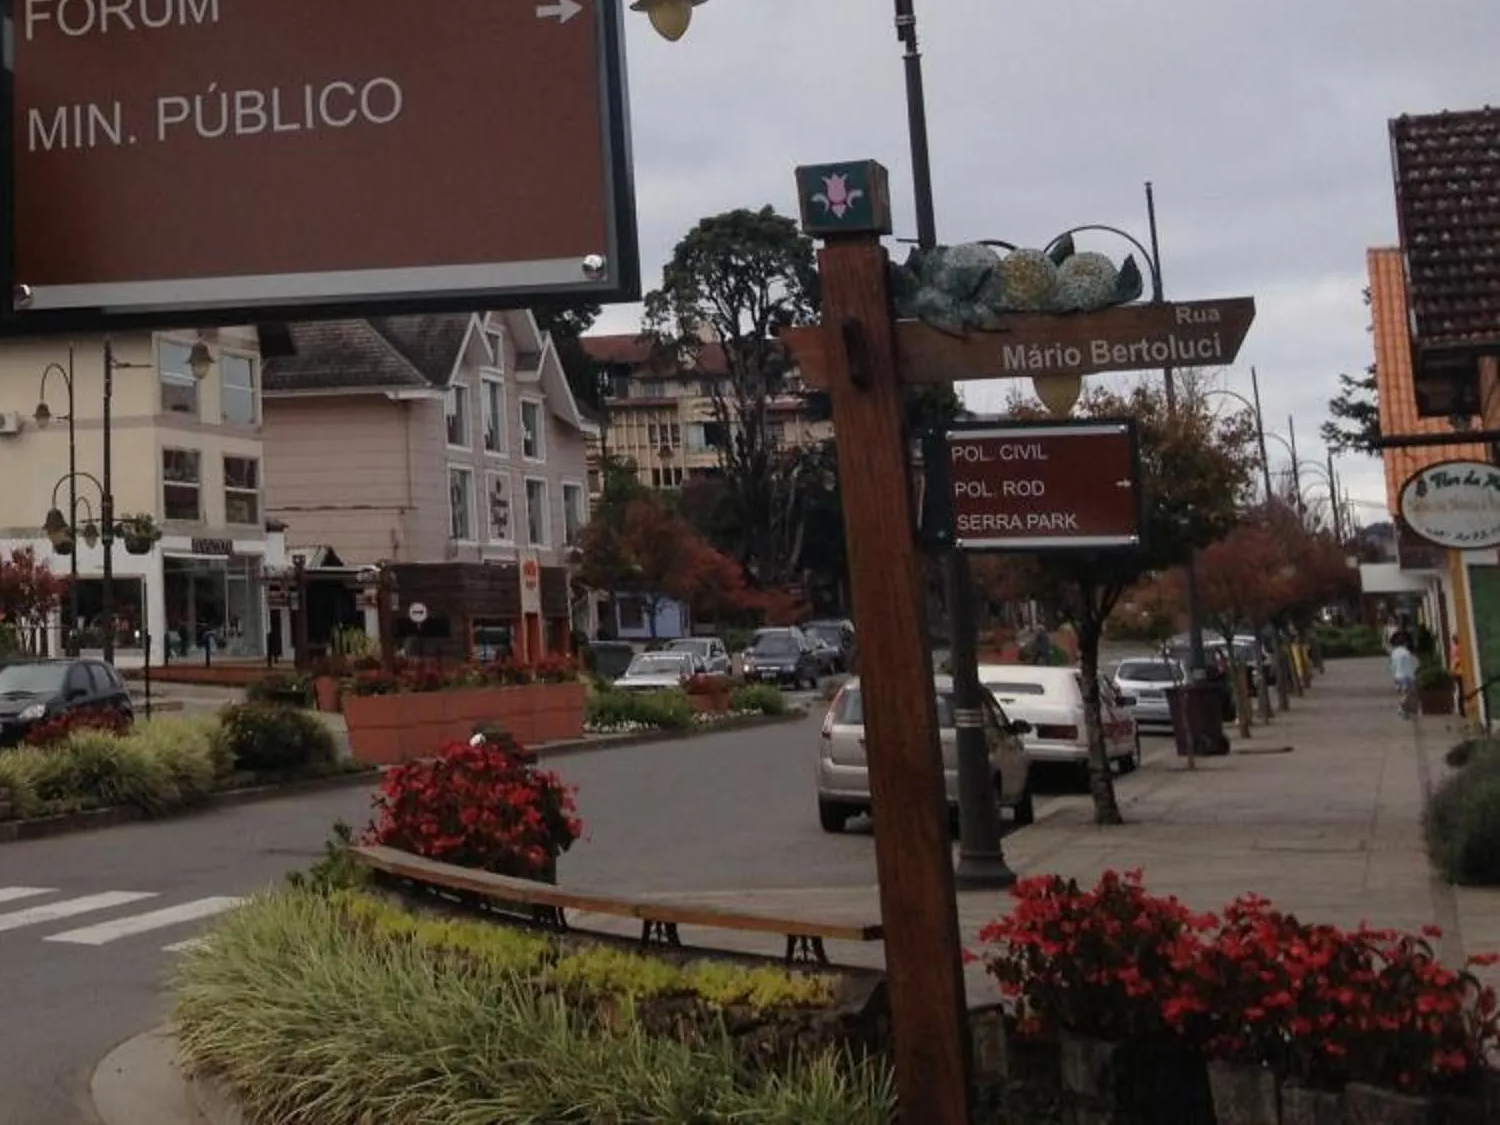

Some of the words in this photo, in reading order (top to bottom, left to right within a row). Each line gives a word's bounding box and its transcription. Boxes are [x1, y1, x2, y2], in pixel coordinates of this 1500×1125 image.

[28, 101, 137, 153] MIN.
[158, 77, 403, 141] PÚBLICO
[1175, 306, 1220, 325] Rua
[1002, 342, 1081, 370] Mário
[1091, 333, 1221, 364] Bertoluci
[1000, 443, 1048, 460] CIVIL
[1003, 480, 1045, 496] ROD
[957, 513, 1023, 530] SERRA
[1027, 513, 1078, 529] PARK
